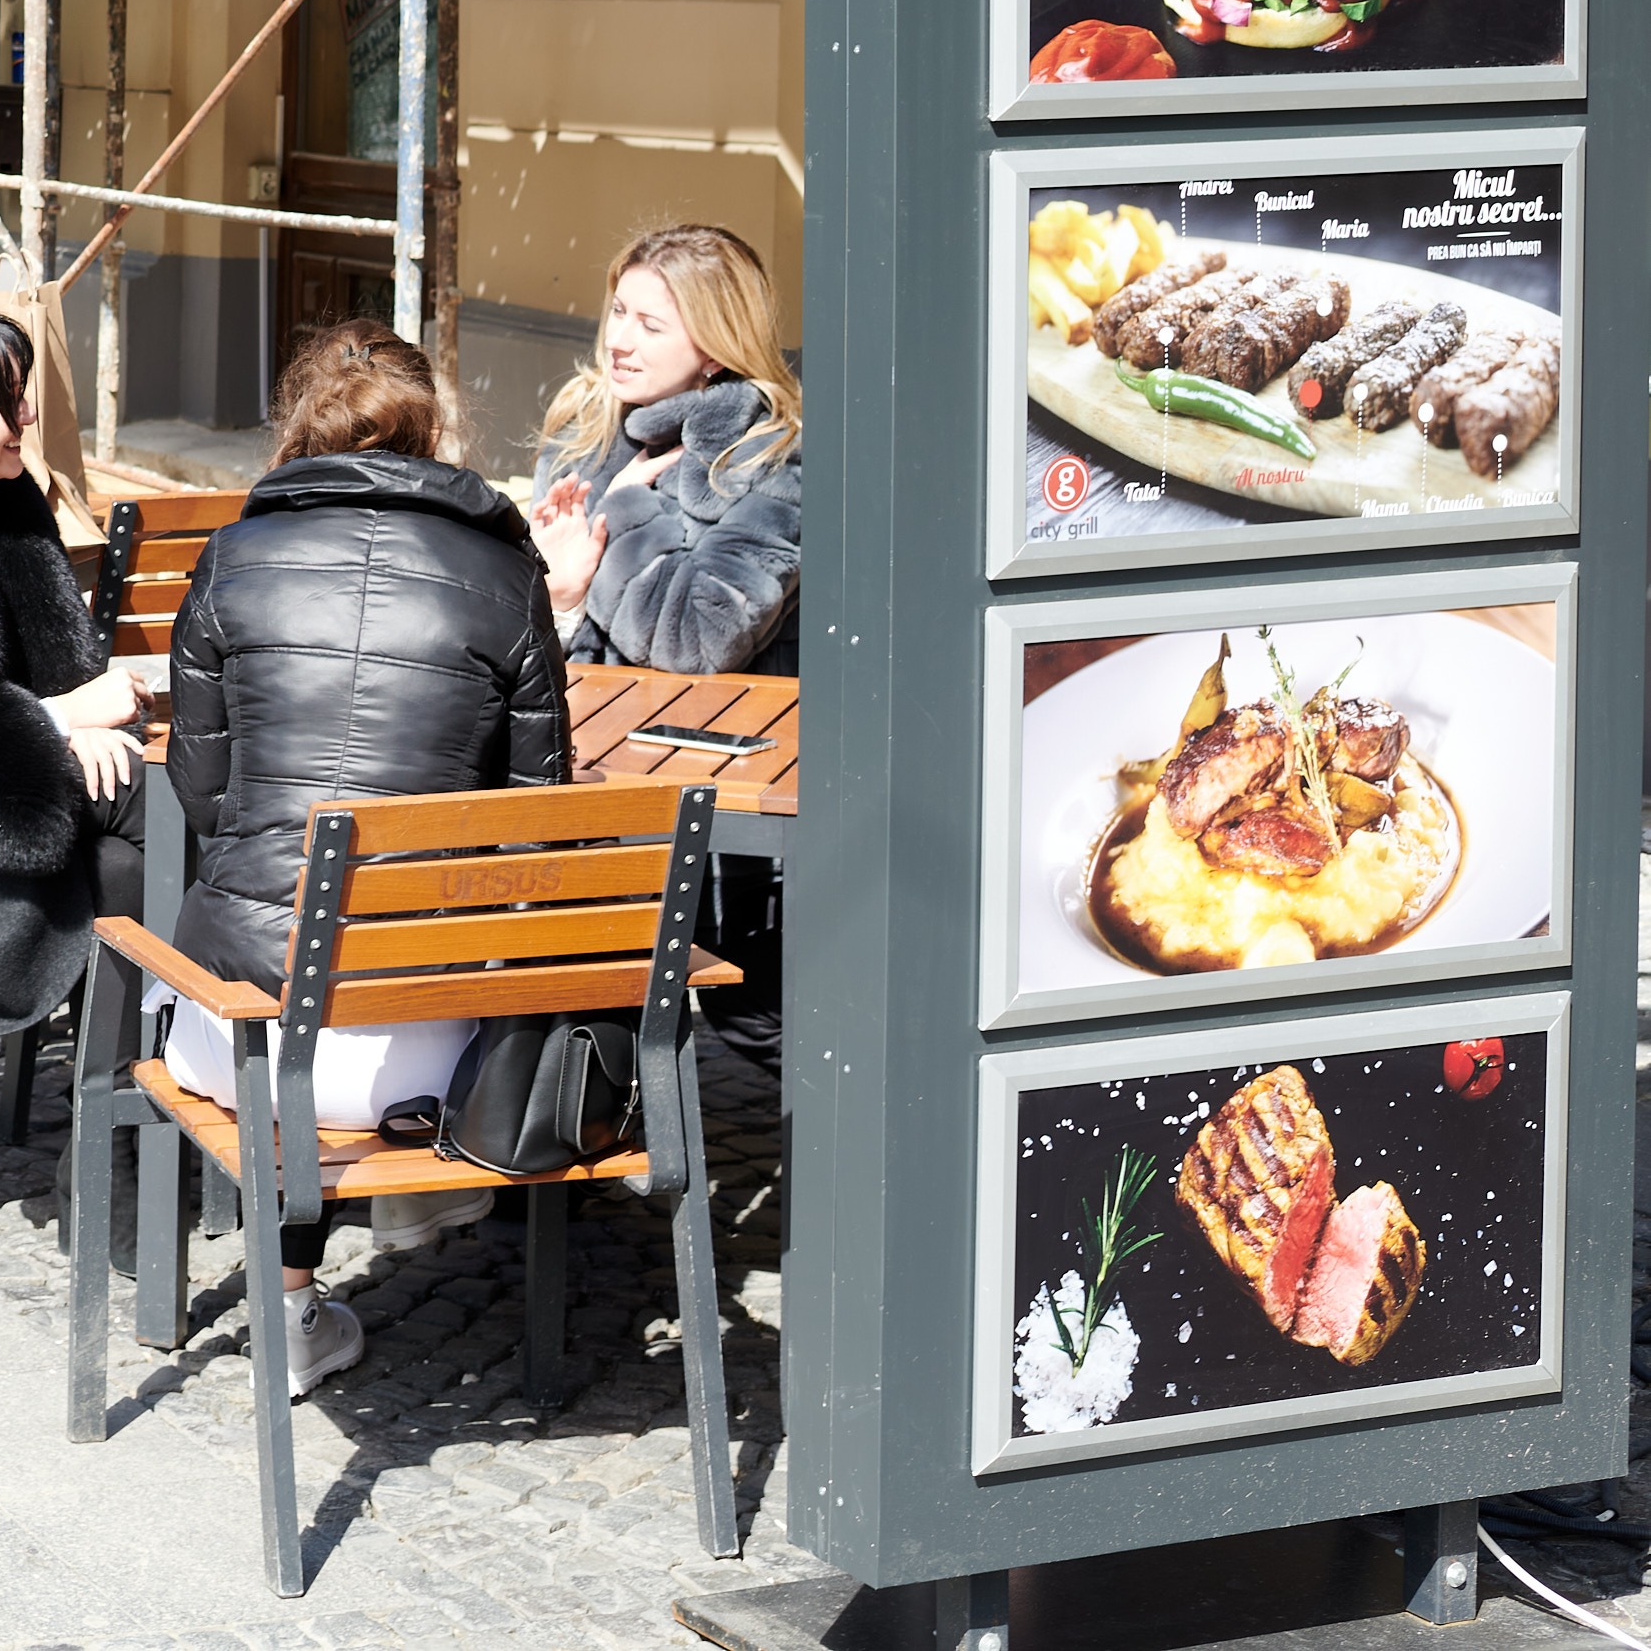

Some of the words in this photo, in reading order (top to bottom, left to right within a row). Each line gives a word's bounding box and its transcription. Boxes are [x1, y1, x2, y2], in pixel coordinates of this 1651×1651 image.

[1453, 169, 1516, 199] Micul
[1254, 190, 1315, 212] Bunicul
[1402, 200, 1476, 229] nostru
[1477, 196, 1563, 225] secret...
[1321, 219, 1370, 240] Maria
[1427, 245, 1449, 261] PREA
[1450, 243, 1467, 259] BUN
[1467, 243, 1479, 258] CA
[1492, 242, 1506, 257] NU
[1235, 468, 1254, 490] Al
[1256, 467, 1305, 486] nostru
[1123, 481, 1161, 503] Tata
[1425, 493, 1485, 513] Claudia
[1501, 489, 1554, 508] Bunica
[1361, 499, 1410, 518] Mama
[1030, 520, 1061, 541] city
[1068, 516, 1098, 540] grill
[440, 862, 563, 900] URSUS
